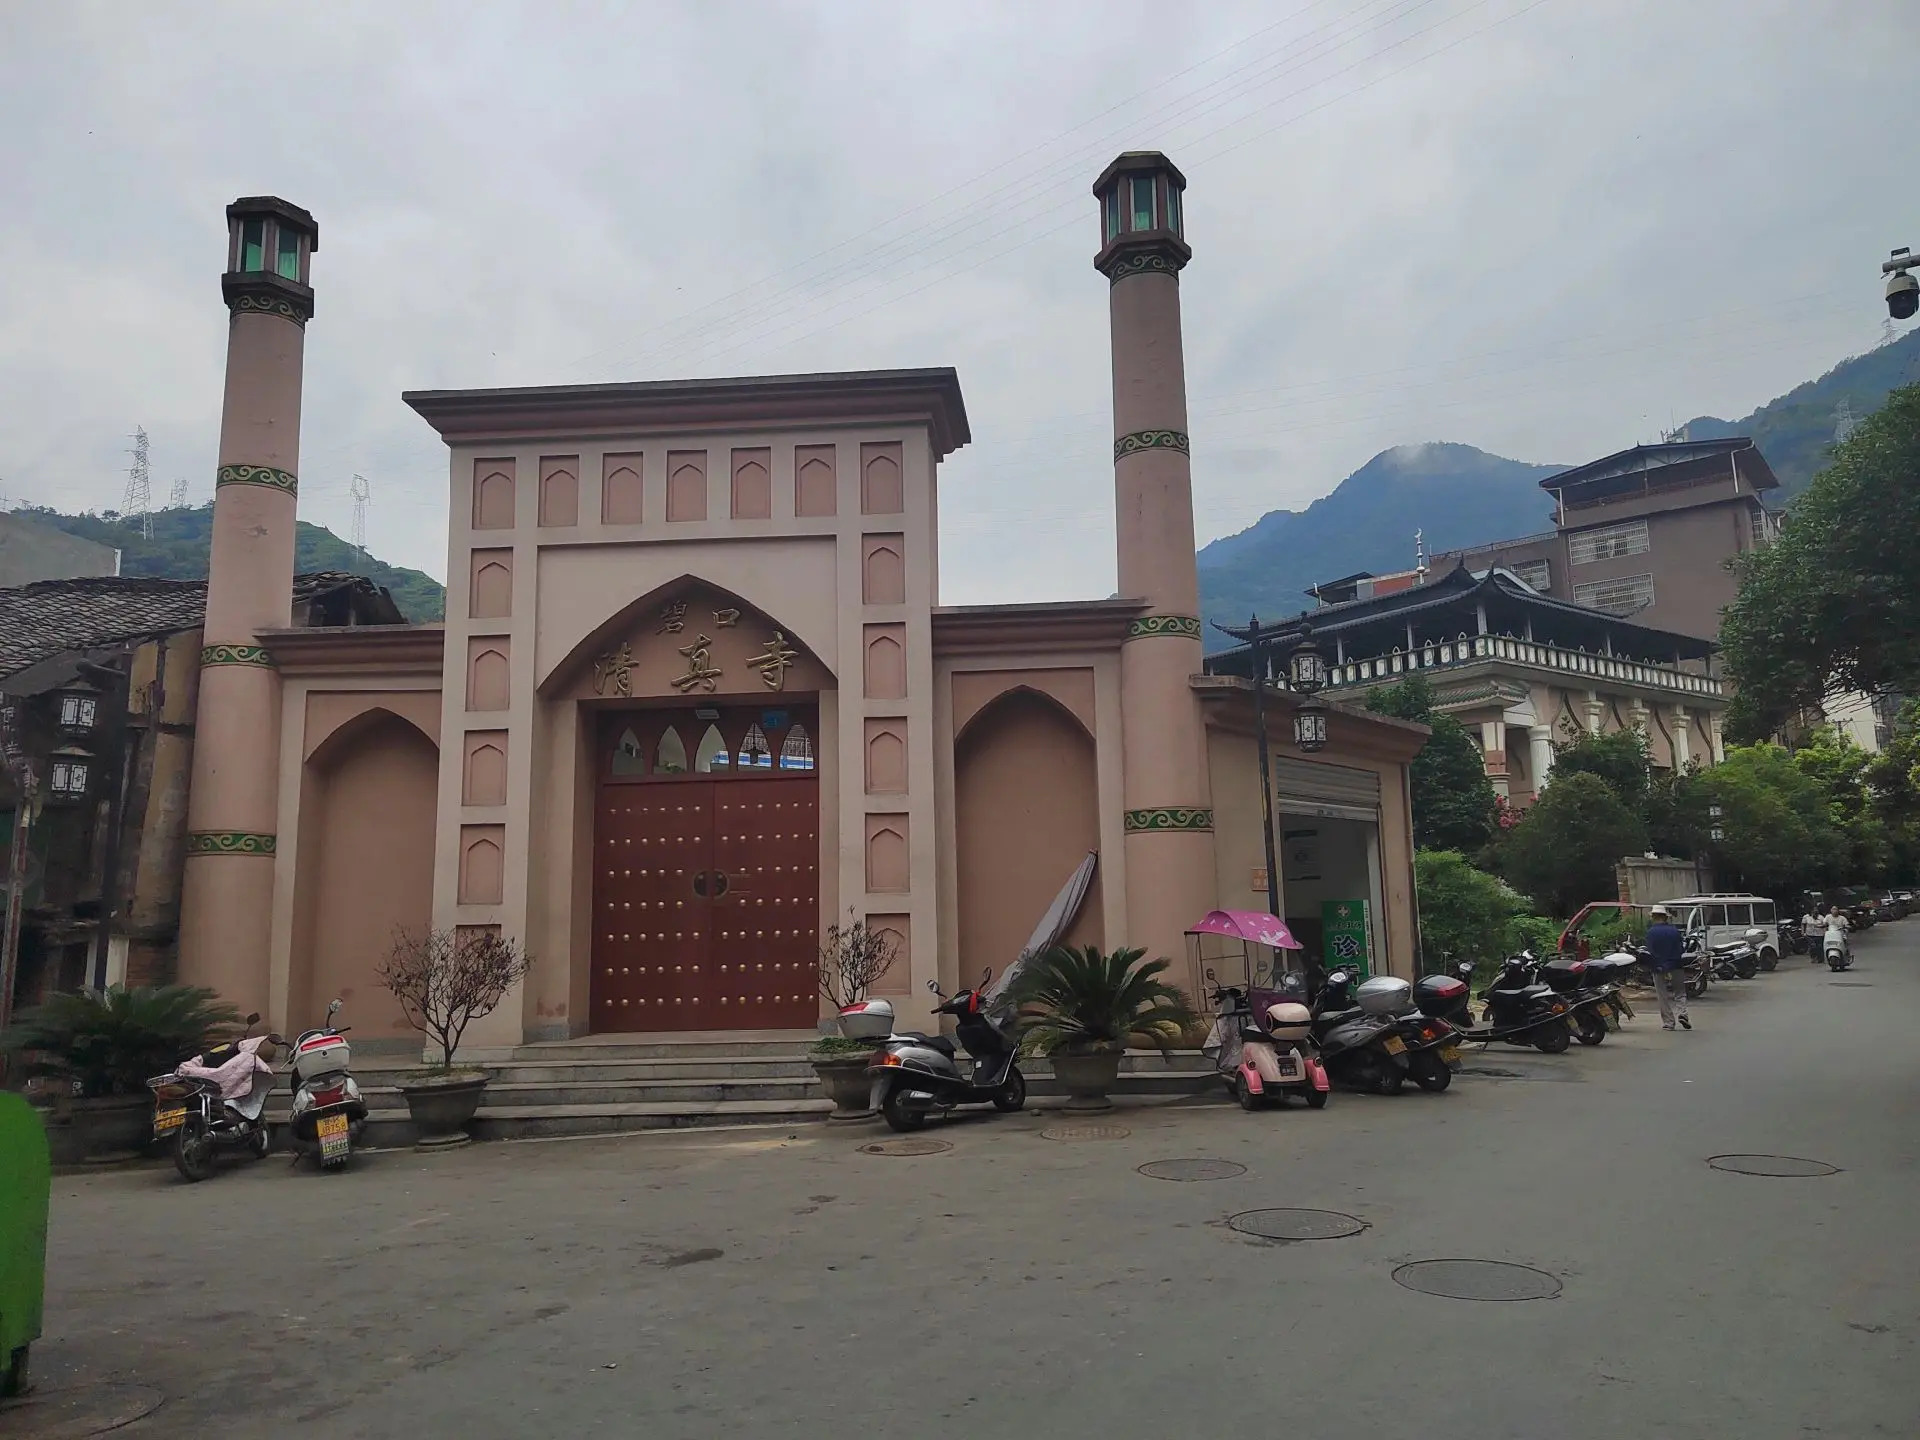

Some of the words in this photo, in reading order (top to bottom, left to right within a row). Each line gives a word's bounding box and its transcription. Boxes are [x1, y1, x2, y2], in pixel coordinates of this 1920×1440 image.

[656, 599, 742, 636] 碧口
[592, 630, 800, 698] 清真寺
